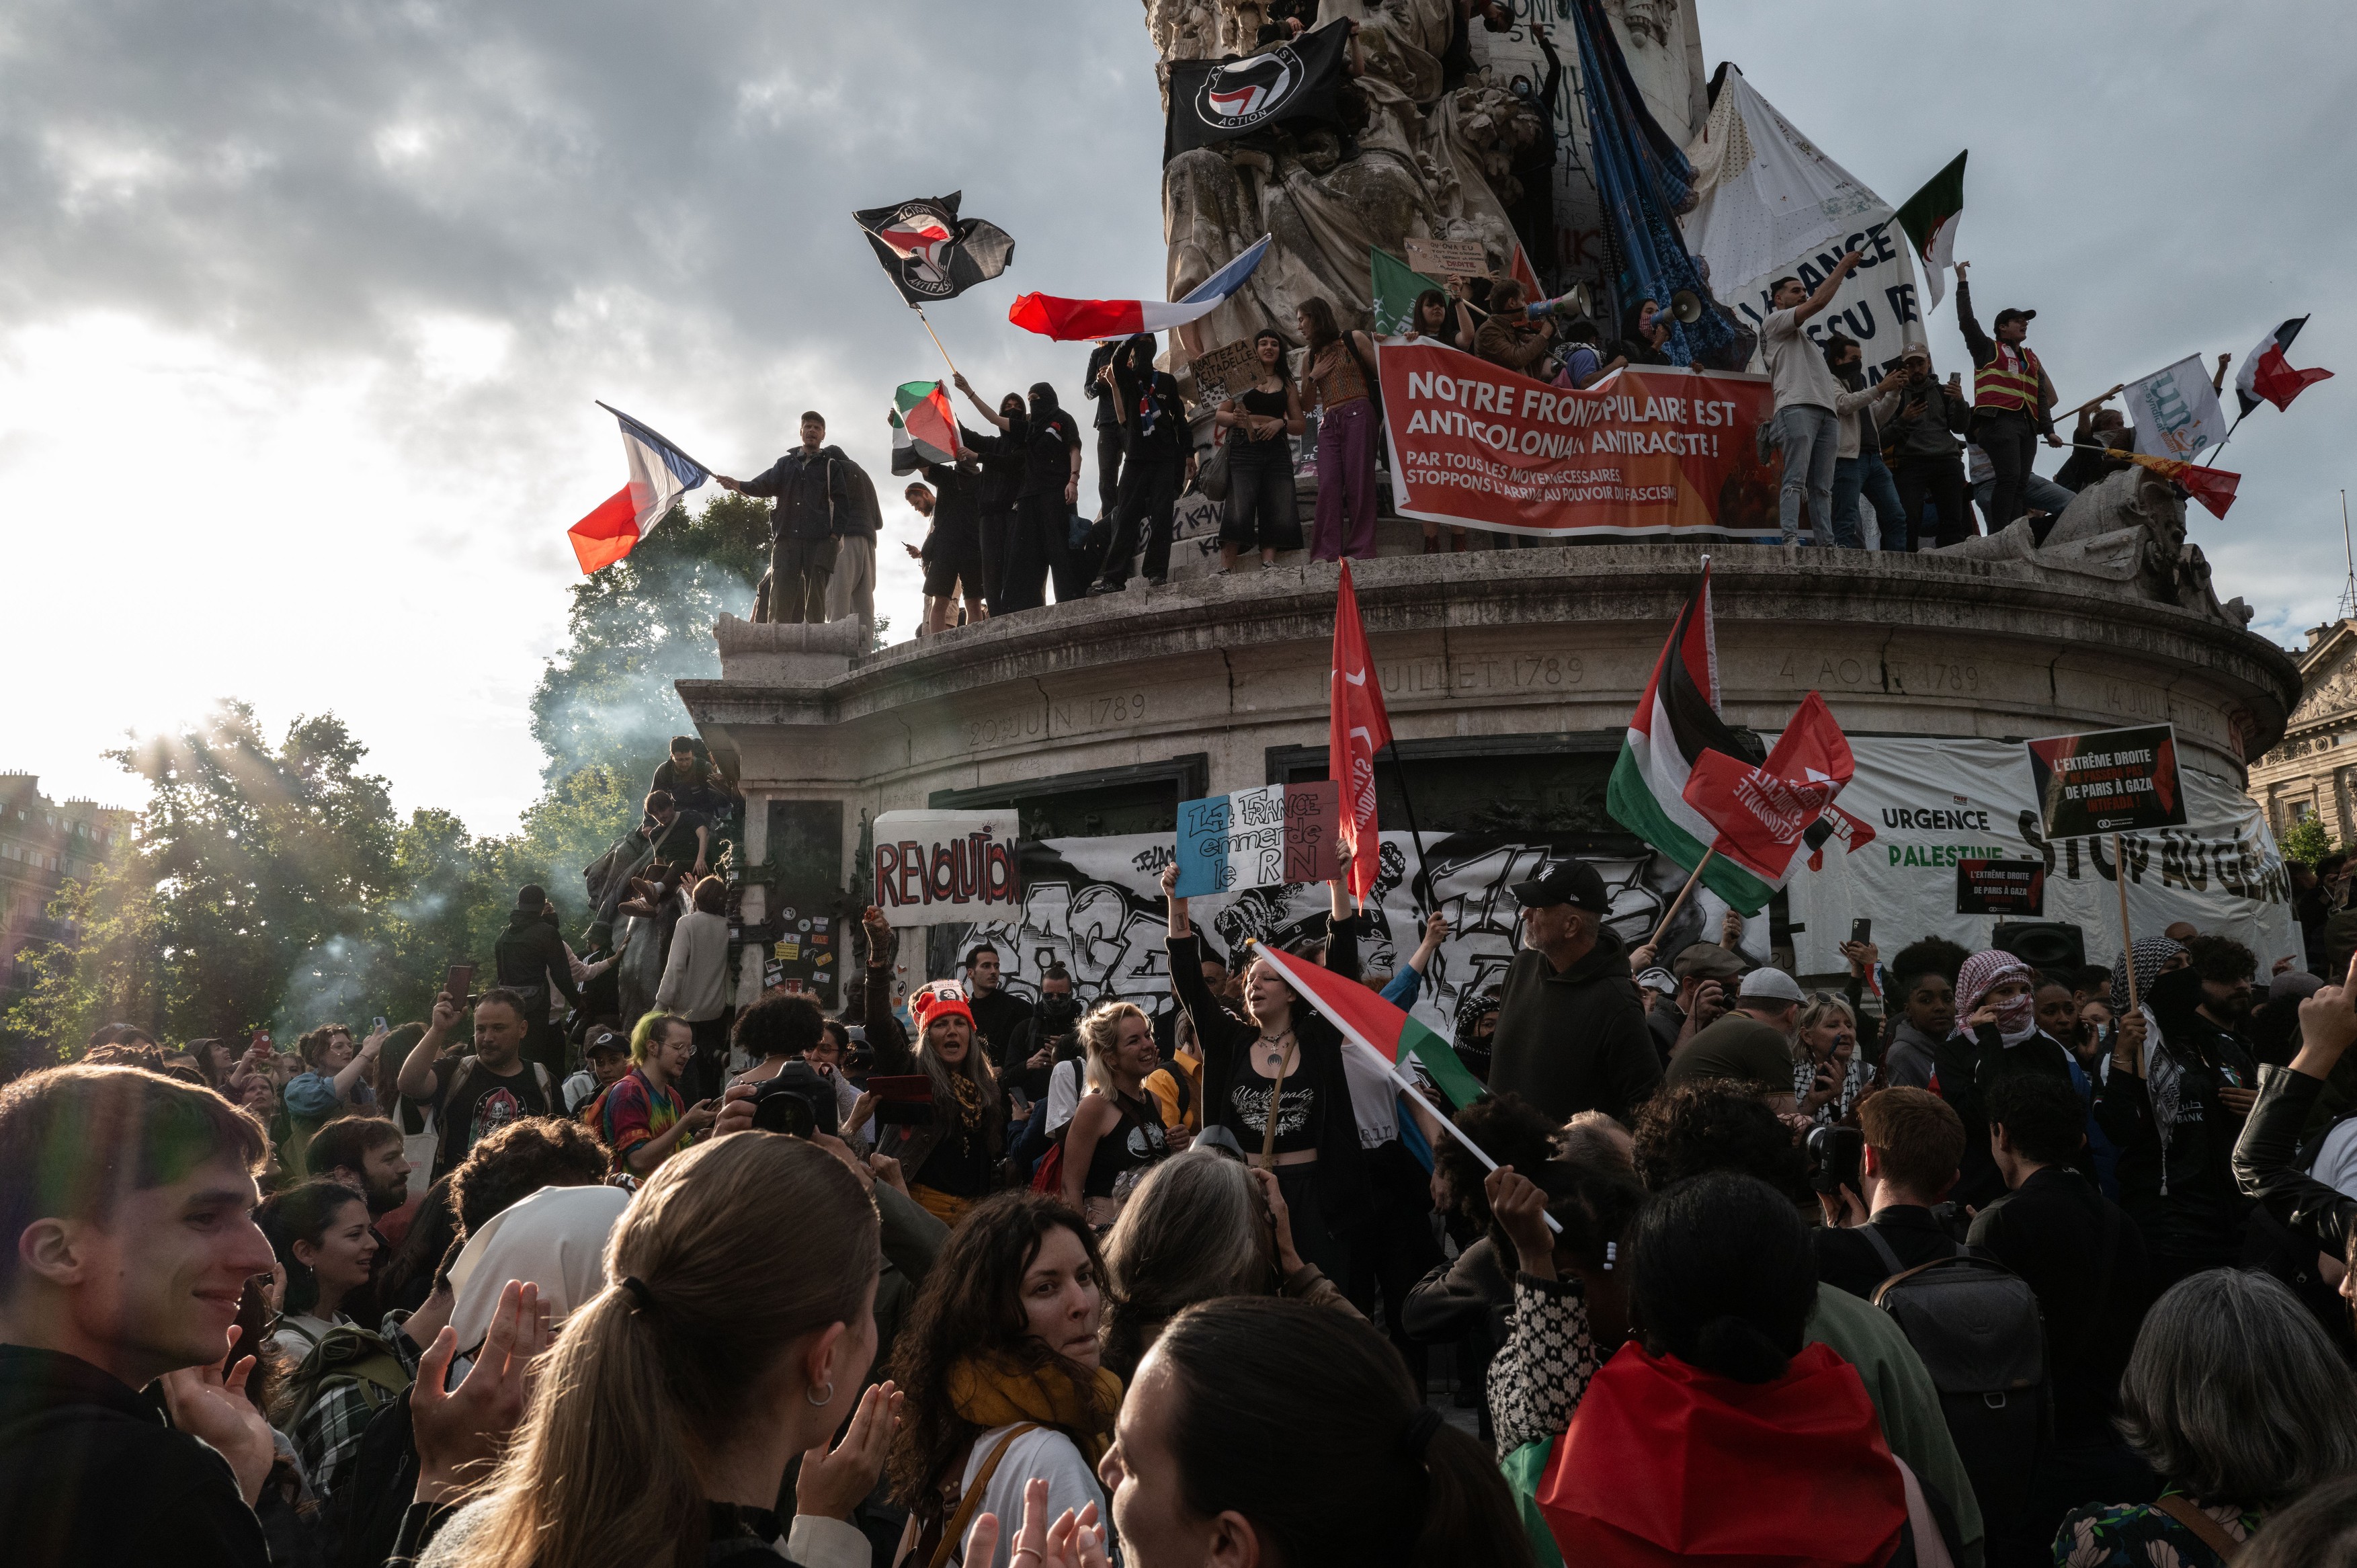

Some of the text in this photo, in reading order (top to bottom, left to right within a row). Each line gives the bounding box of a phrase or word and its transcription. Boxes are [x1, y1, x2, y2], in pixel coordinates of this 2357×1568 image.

[1218, 110, 1267, 126] ACTION
[899, 206, 933, 222] ACTION
[1192, 341, 1248, 372] ABATTEZ LA
[1409, 371, 1516, 415] NOTRE
[1694, 399, 1736, 427] EST
[1407, 451, 1441, 466] PAR
[1445, 452, 1483, 472] TOUS
[1485, 461, 1508, 479] LES
[1406, 469, 1491, 492] STOPPONS
[1544, 488, 1561, 501] AU
[1563, 486, 1613, 501] POUVOIR
[1615, 487, 1624, 501] DU
[1382, 661, 1499, 692] UILLET
[1514, 657, 1584, 687] 1789
[1924, 663, 1979, 691] 1789
[970, 720, 997, 746] 20
[1090, 694, 1145, 726] 1789
[2114, 749, 2152, 766] DROITE
[2084, 768, 2124, 782] PASSERA
[2126, 766, 2144, 778] PAS
[2065, 778, 2154, 800] DE PARIS À GAZA
[1239, 789, 1321, 825] FRANCE
[2086, 796, 2135, 813] INTIFADA
[1882, 809, 1991, 831] URGENCE
[1200, 818, 1322, 857] emmerde
[1214, 845, 1317, 889] le RN
[1888, 845, 2003, 868] PALESTINE
[2007, 872, 2029, 880] DROITE
[1984, 886, 2002, 895] PARIS
[2177, 1112, 2204, 1124] BANK
